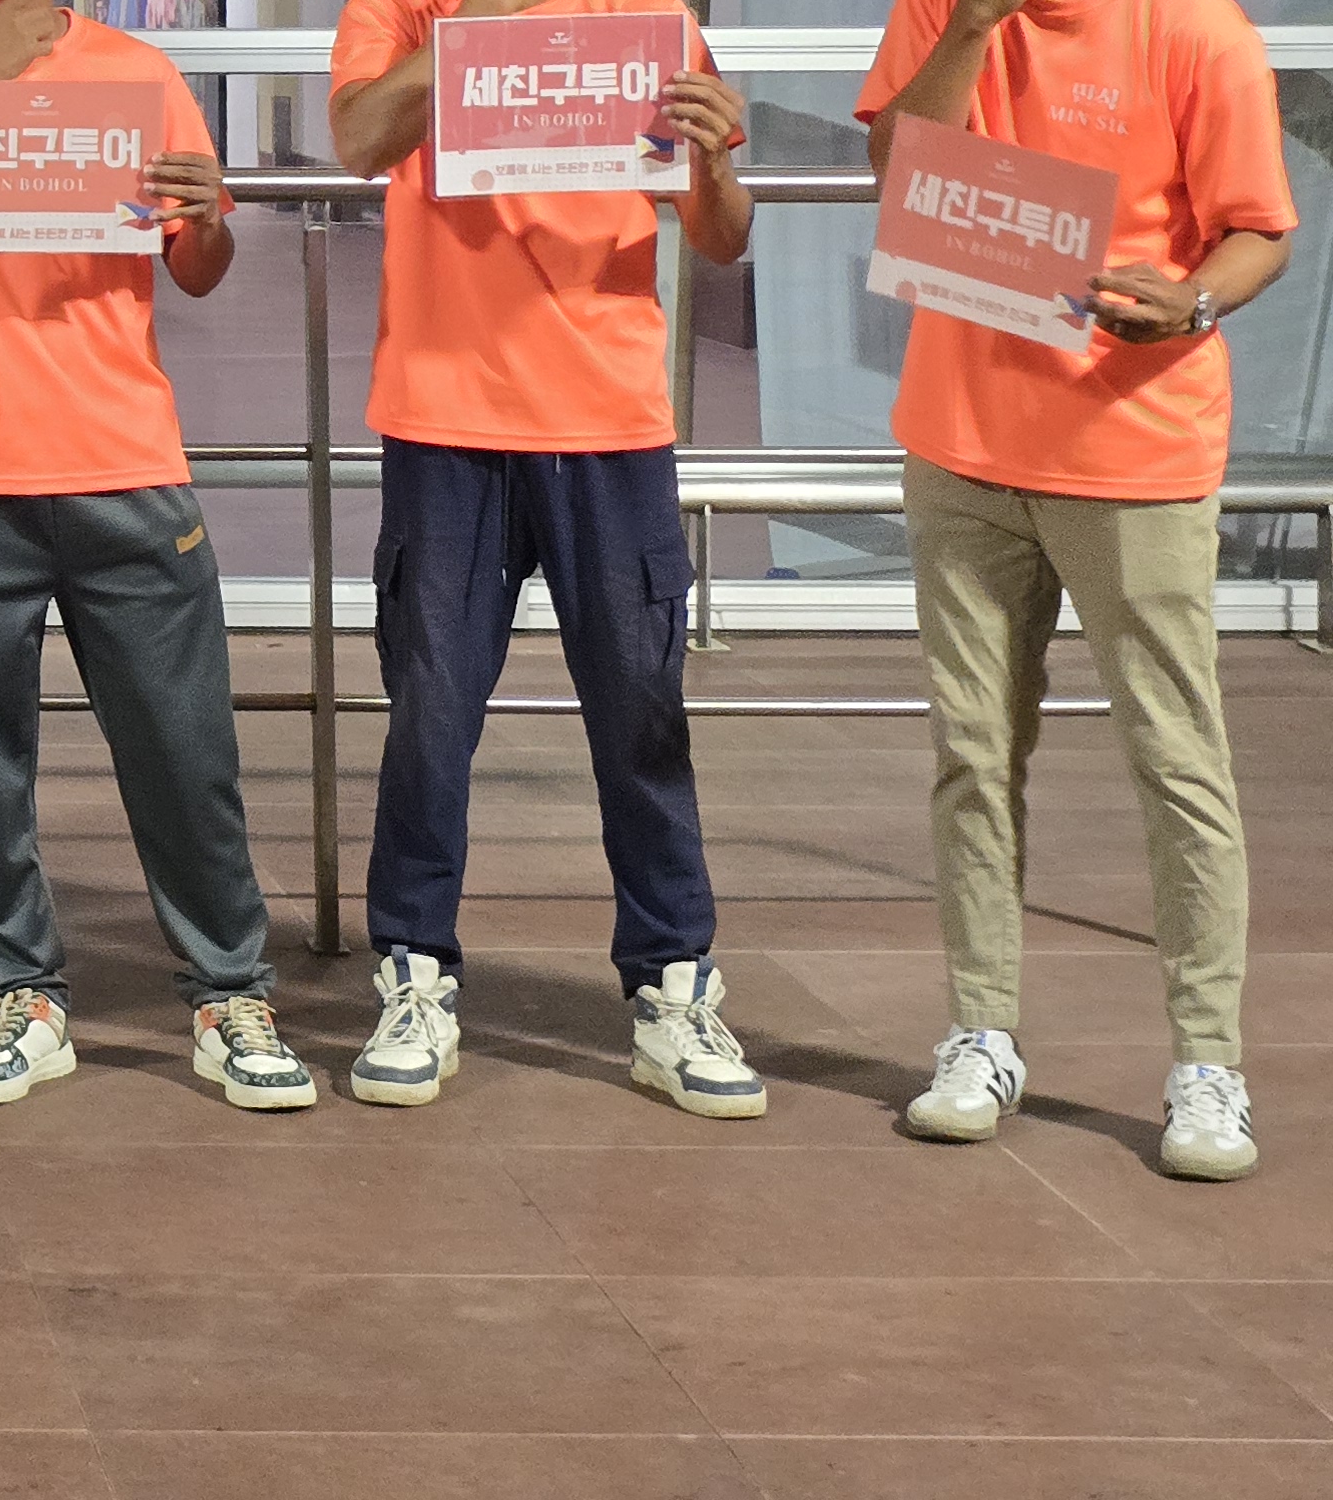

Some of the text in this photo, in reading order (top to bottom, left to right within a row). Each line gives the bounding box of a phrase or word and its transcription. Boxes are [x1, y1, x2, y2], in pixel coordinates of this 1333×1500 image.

[462, 61, 660, 108] 세친구투어
[513, 112, 607, 128] IN BOHOL
[1050, 104, 1089, 127] MIN
[19, 177, 88, 192] BOHOL
[903, 169, 1091, 261] 세친구투어
